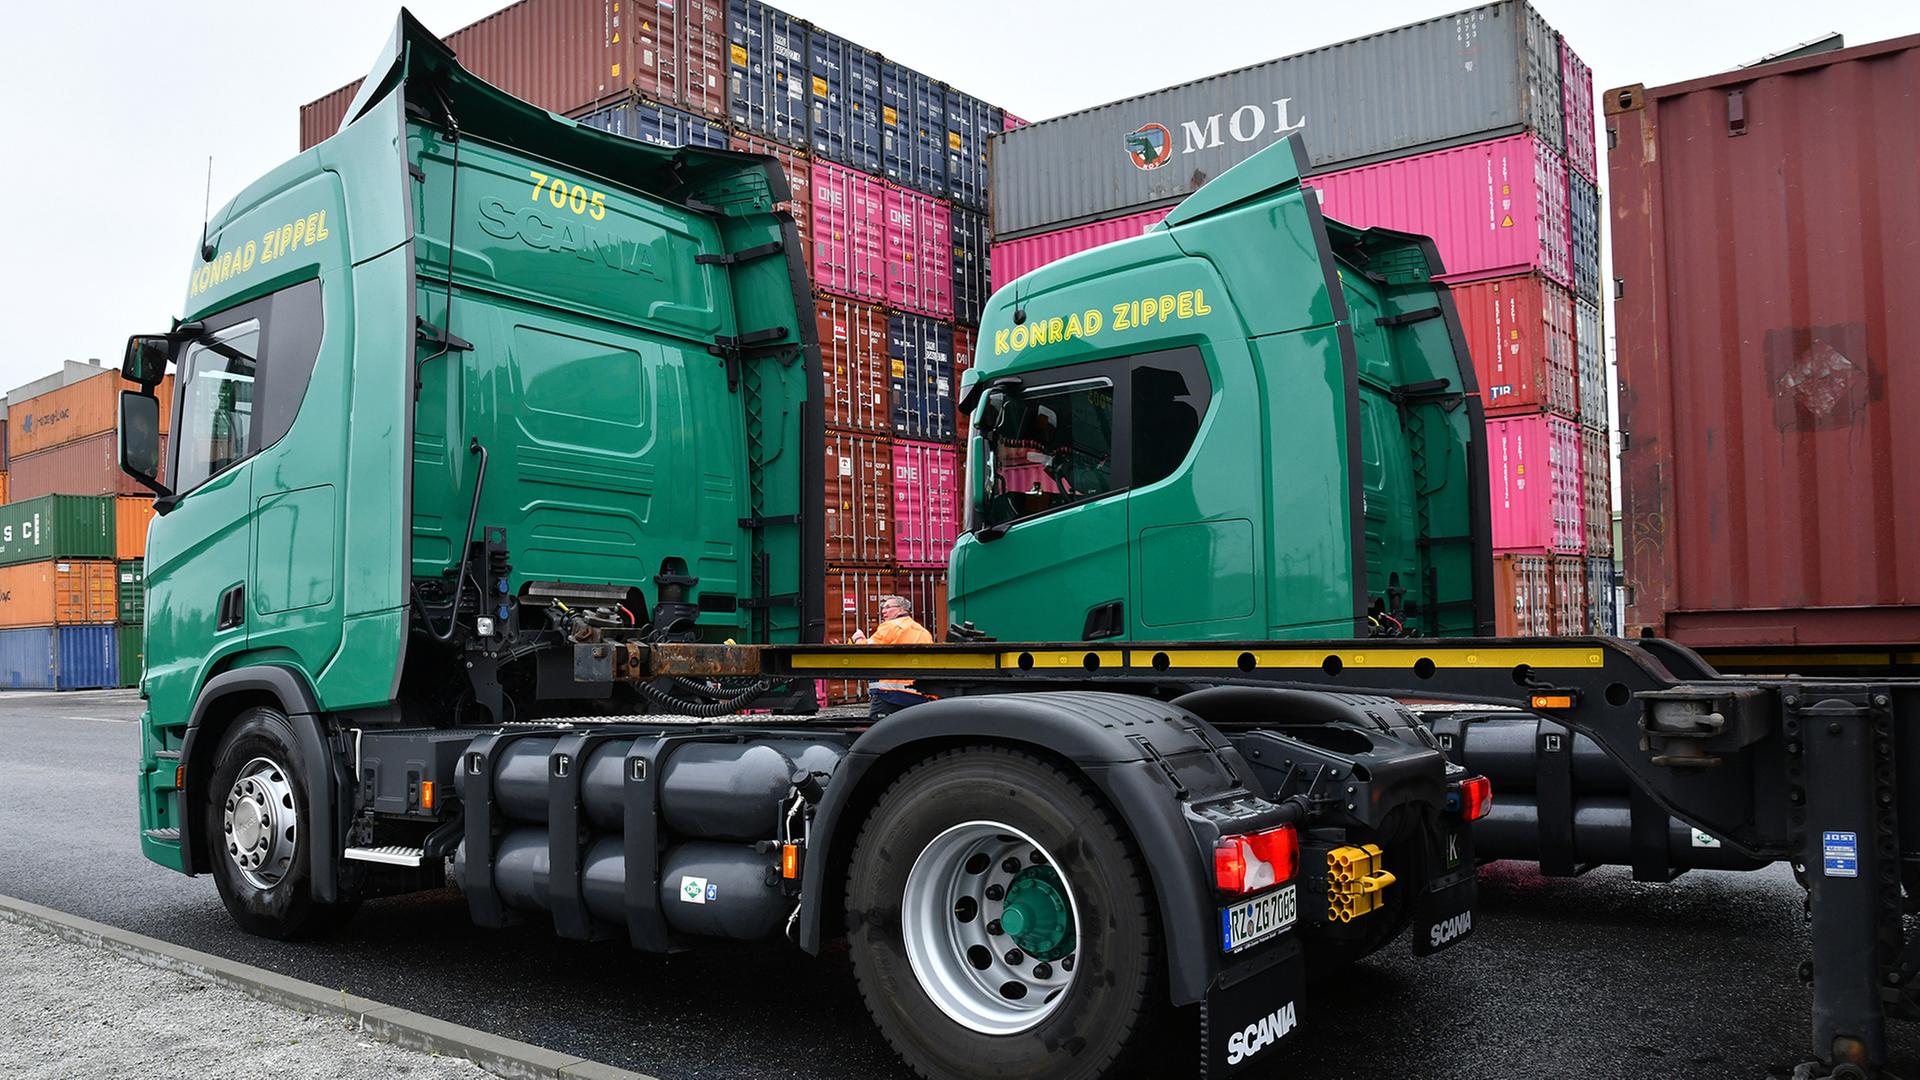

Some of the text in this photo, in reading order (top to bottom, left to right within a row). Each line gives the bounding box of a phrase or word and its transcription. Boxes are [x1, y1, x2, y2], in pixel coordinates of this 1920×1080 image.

[1181, 97, 1306, 154] MOL
[529, 171, 606, 221] 7005
[190, 209, 329, 299] KONRAD ZIPPEL
[478, 196, 664, 283] SCANIA
[995, 310, 1103, 356] KONRAD
[1112, 288, 1211, 332] ZIPPEL
[1490, 385, 1512, 400] TIR
[896, 466, 918, 481] ONE
[1231, 907, 1248, 943] RZ
[1255, 899, 1270, 933] ZG
[1430, 910, 1472, 947] SCANIA
[1227, 1000, 1298, 1065] SCANIA
